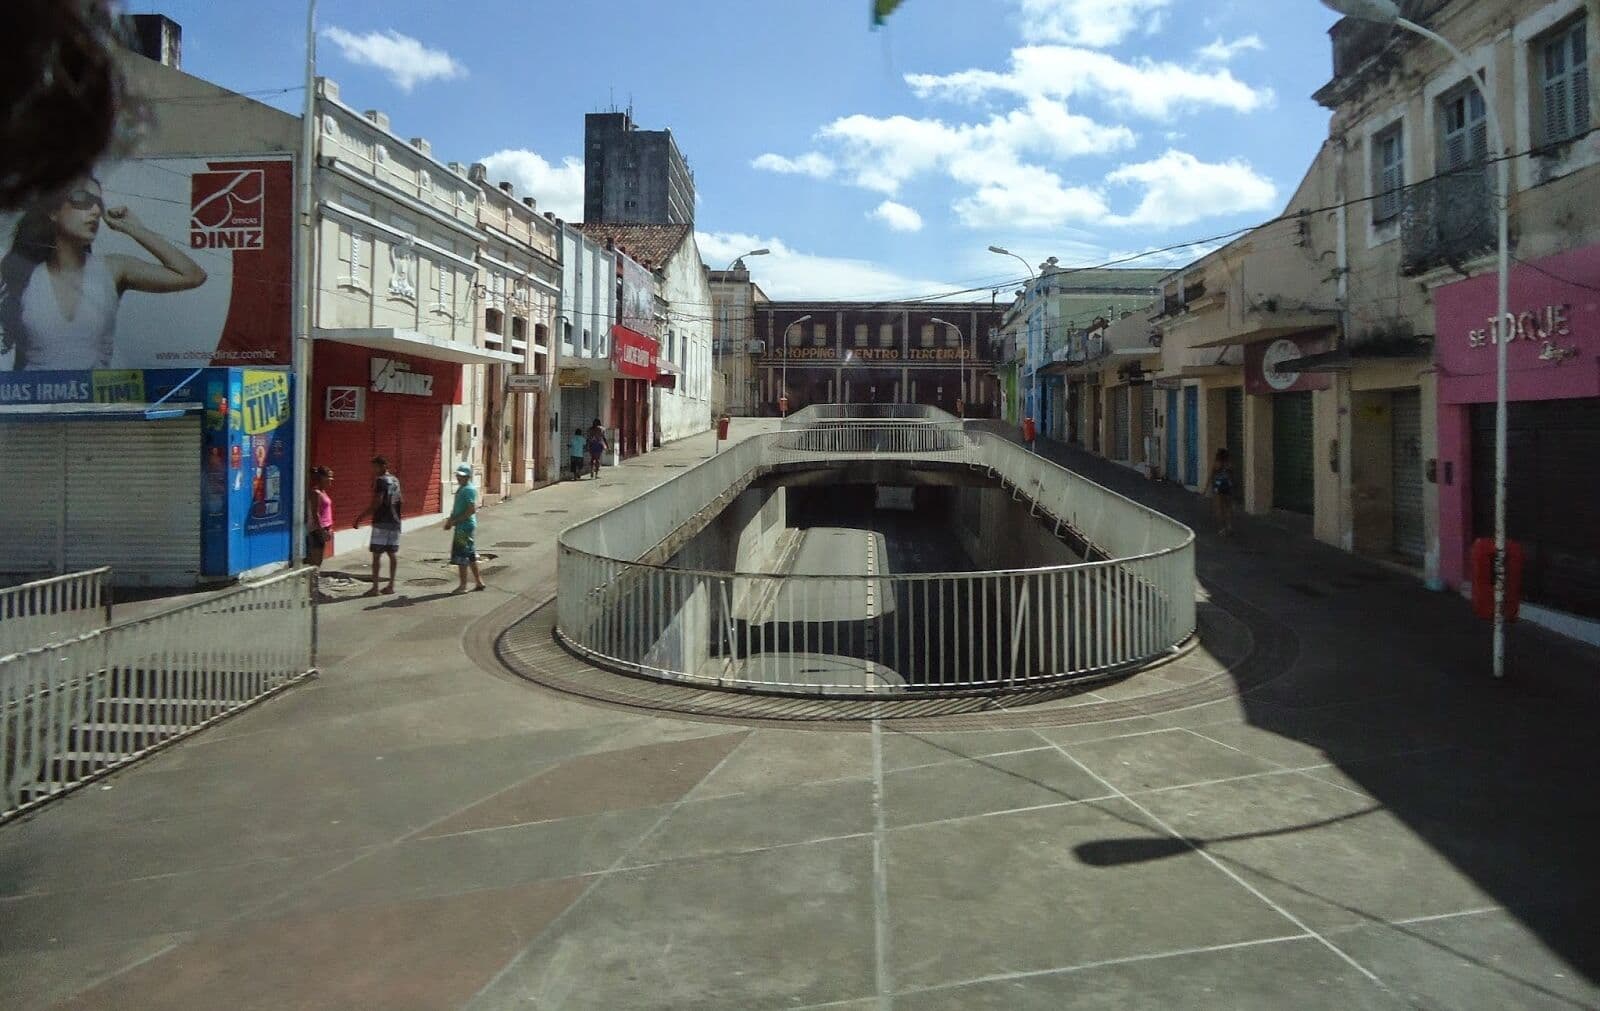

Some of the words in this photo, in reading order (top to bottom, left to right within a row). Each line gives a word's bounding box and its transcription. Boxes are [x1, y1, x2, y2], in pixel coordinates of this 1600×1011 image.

[191, 230, 261, 248] DINIZ
[1469, 329, 1486, 349] SE
[1488, 305, 1570, 344] TOQUE
[37, 380, 89, 400] IRMÃS
[246, 391, 281, 430] TIM
[329, 410, 356, 419] DINIZ
